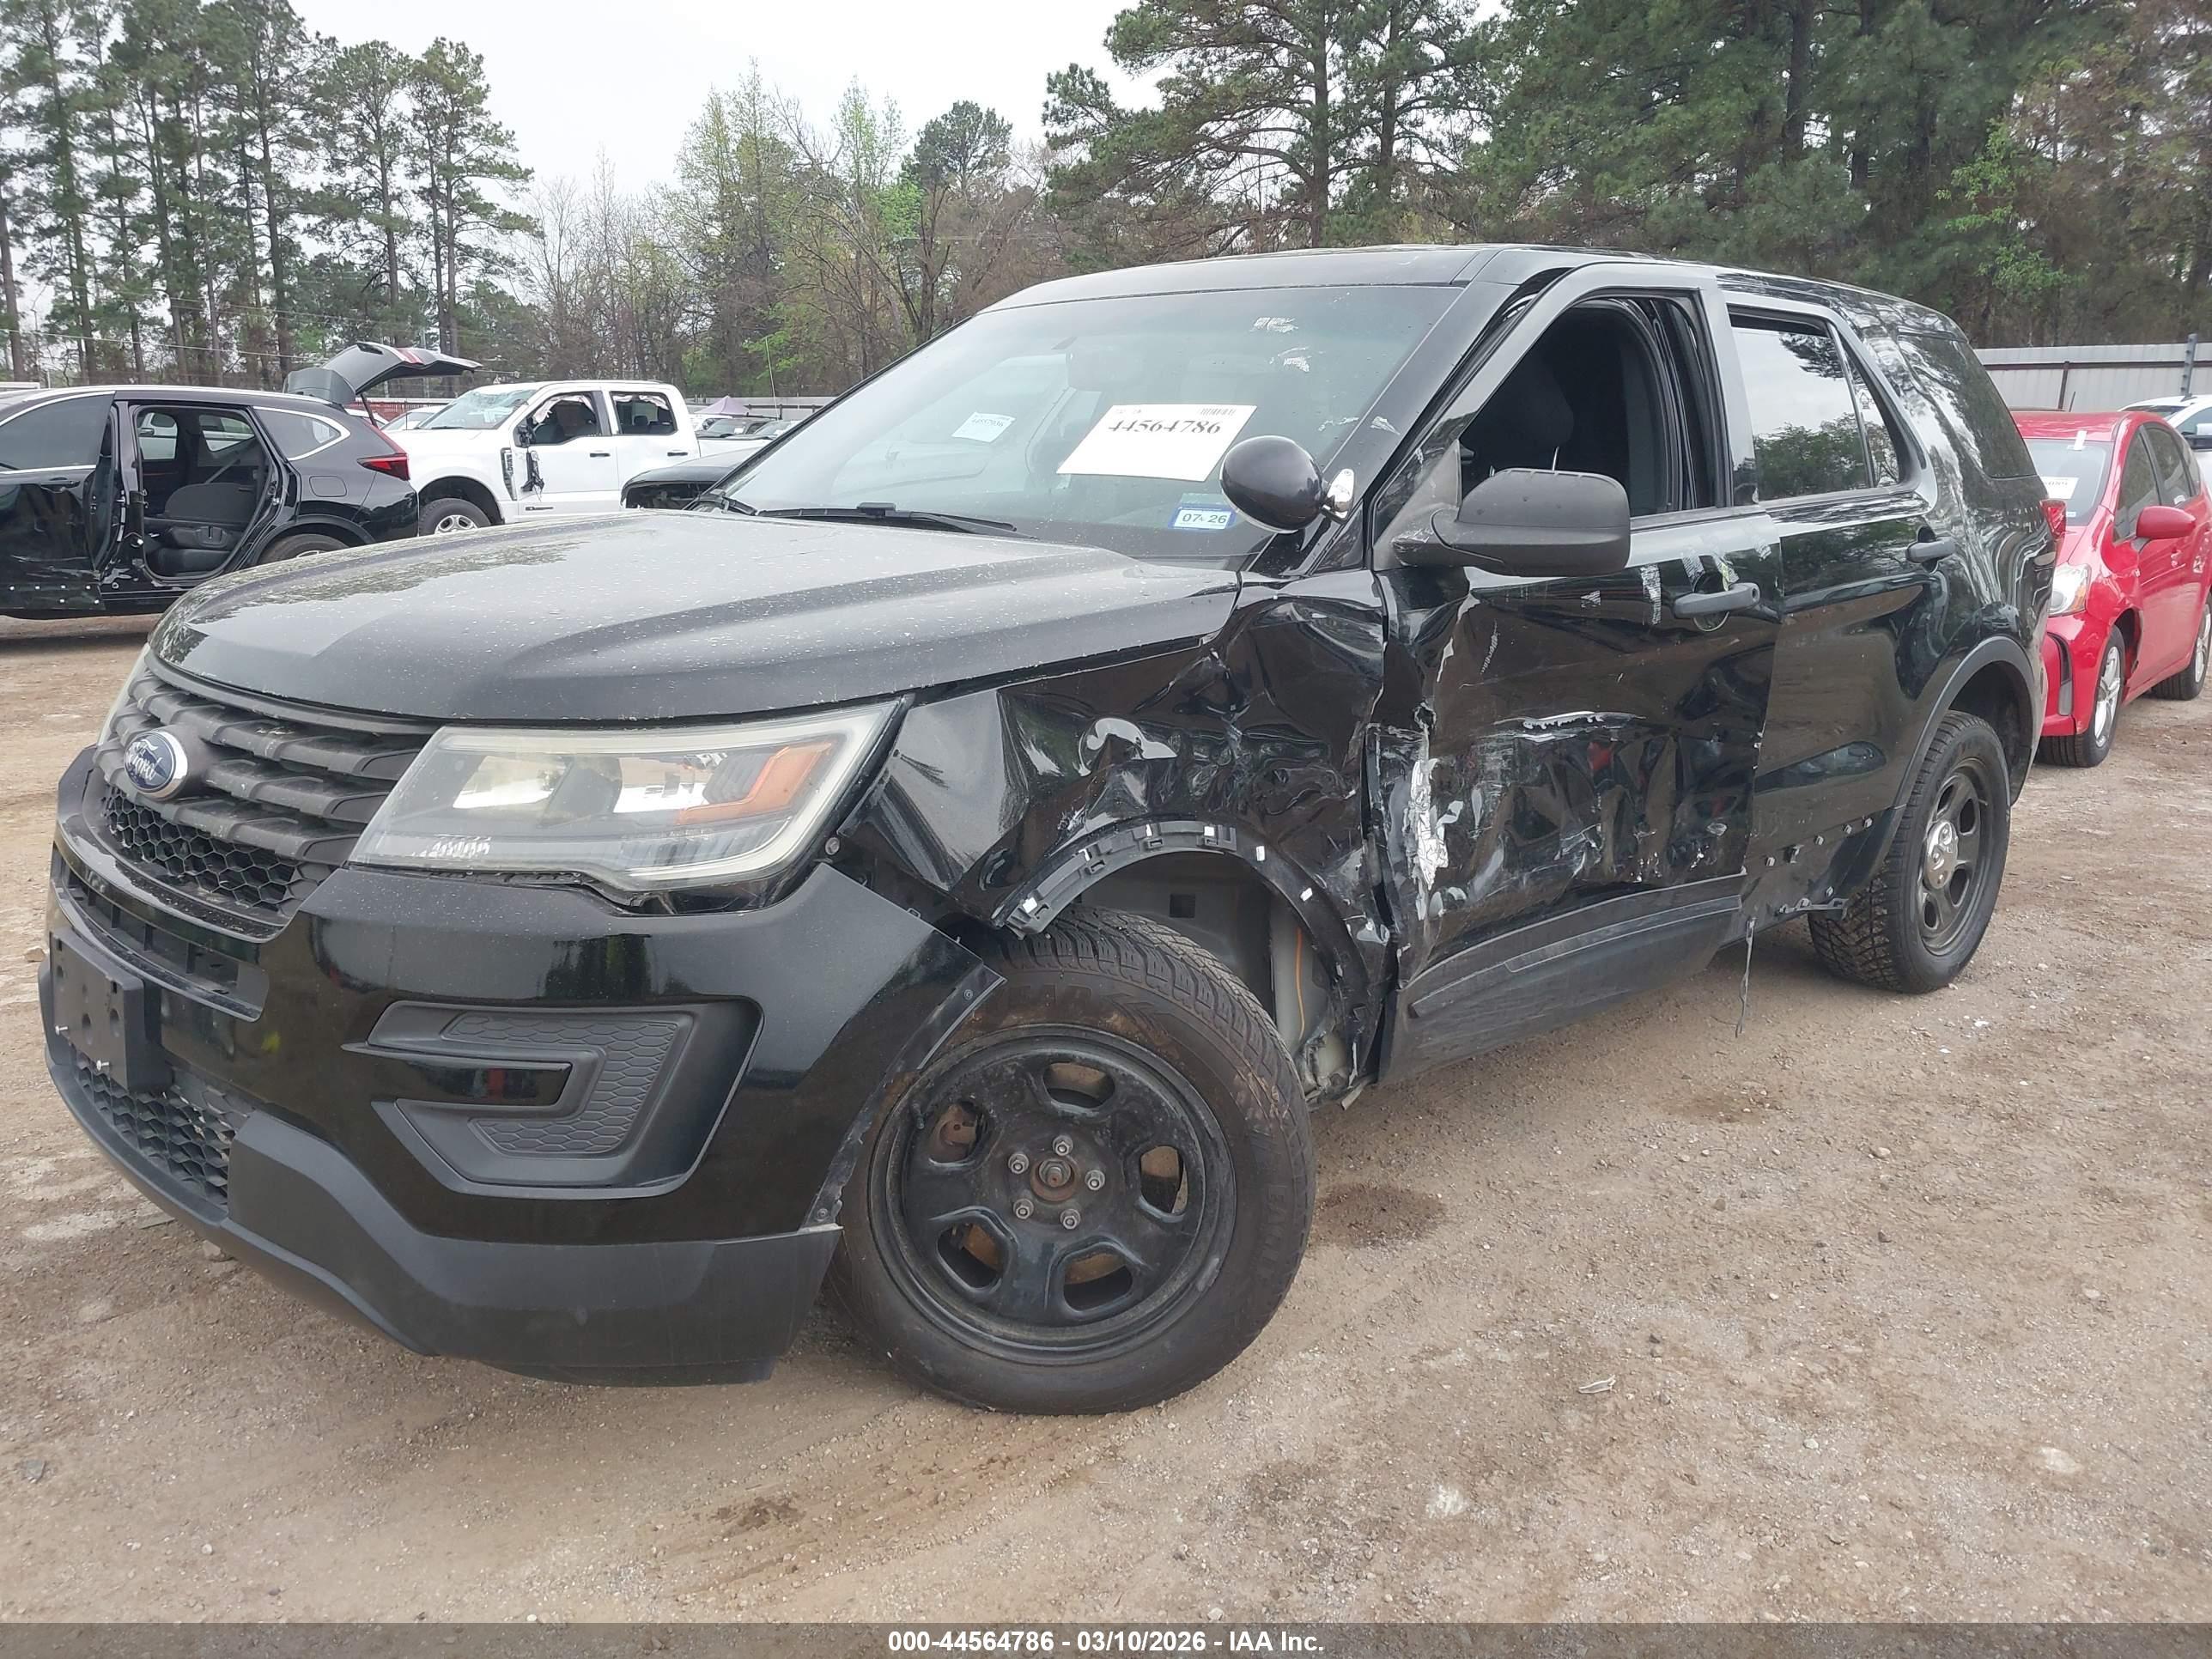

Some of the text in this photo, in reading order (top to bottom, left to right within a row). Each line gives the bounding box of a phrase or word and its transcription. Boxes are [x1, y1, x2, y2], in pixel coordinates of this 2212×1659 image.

[1108, 419, 1222, 434] 44564786
[1182, 514, 1228, 524] 07 26
